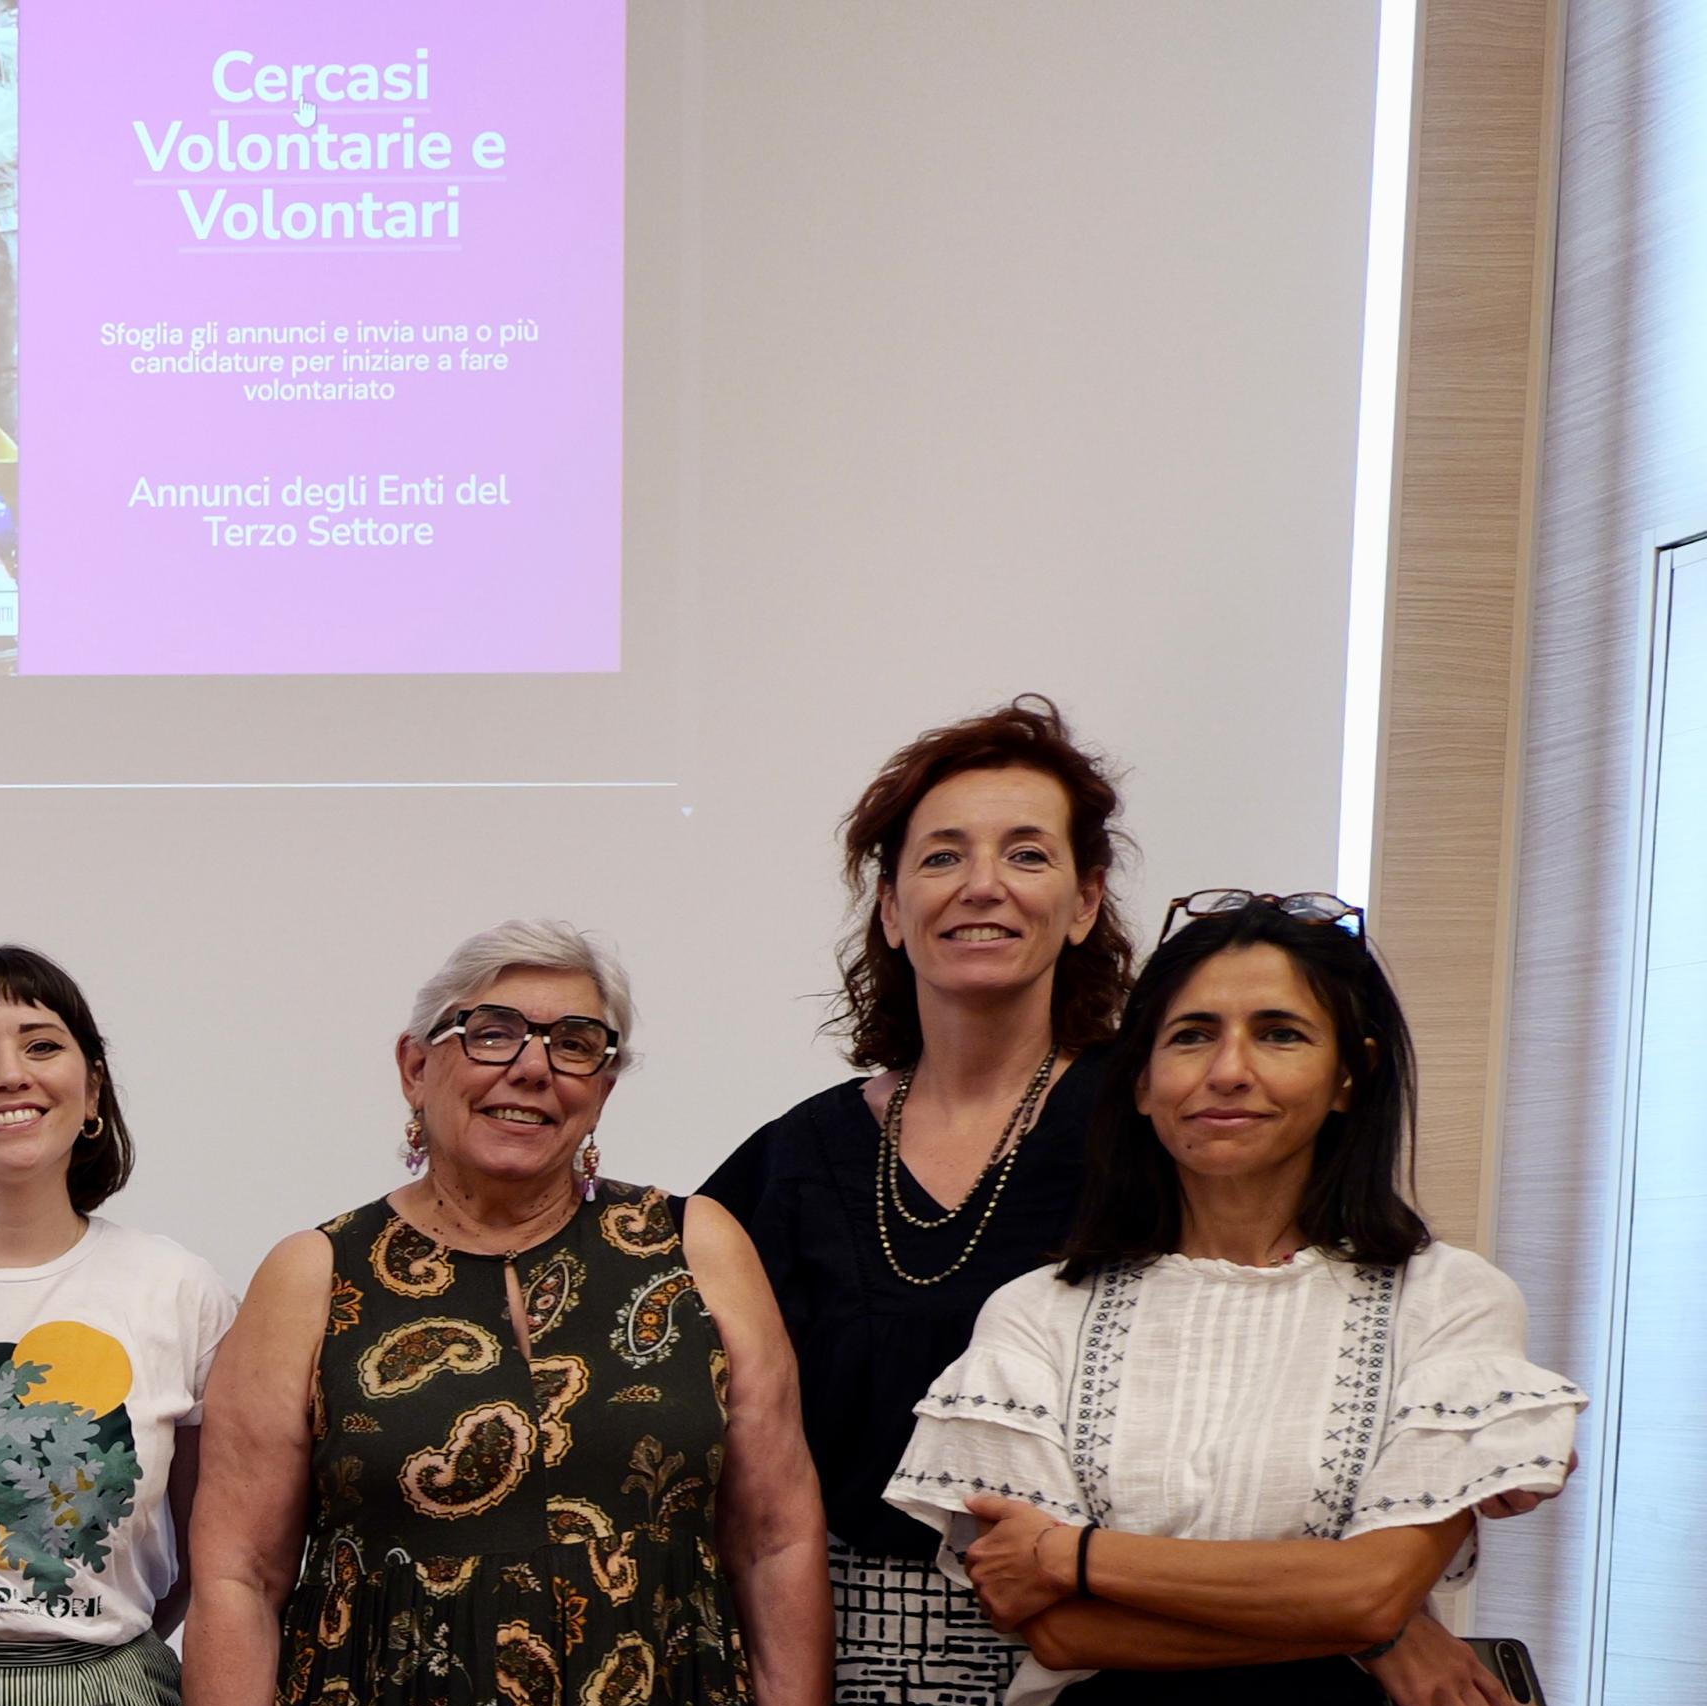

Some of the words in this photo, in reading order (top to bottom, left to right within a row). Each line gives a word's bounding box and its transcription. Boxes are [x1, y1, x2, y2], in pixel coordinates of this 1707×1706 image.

[212, 48, 430, 102] Cercasi
[133, 118, 452, 172] Volontarie
[472, 131, 506, 169] e
[178, 186, 460, 240] Volontari
[100, 322, 183, 350] Sfoglia
[190, 322, 218, 351] gli
[226, 321, 326, 345] annunci
[334, 326, 349, 344] e
[356, 320, 415, 343] invia
[422, 324, 469, 343] una
[476, 324, 492, 343] o
[499, 318, 539, 347] più
[130, 349, 284, 374] candidature
[291, 353, 334, 377] per
[342, 350, 430, 372] iniziare
[437, 353, 453, 371] a
[460, 348, 509, 370] fare
[244, 378, 395, 401] volontariato
[128, 476, 270, 508] Annunci
[281, 476, 367, 513] degli
[379, 475, 444, 506] Enti
[455, 475, 510, 505] del
[203, 516, 297, 548] Terzo
[308, 515, 434, 546] Settore
